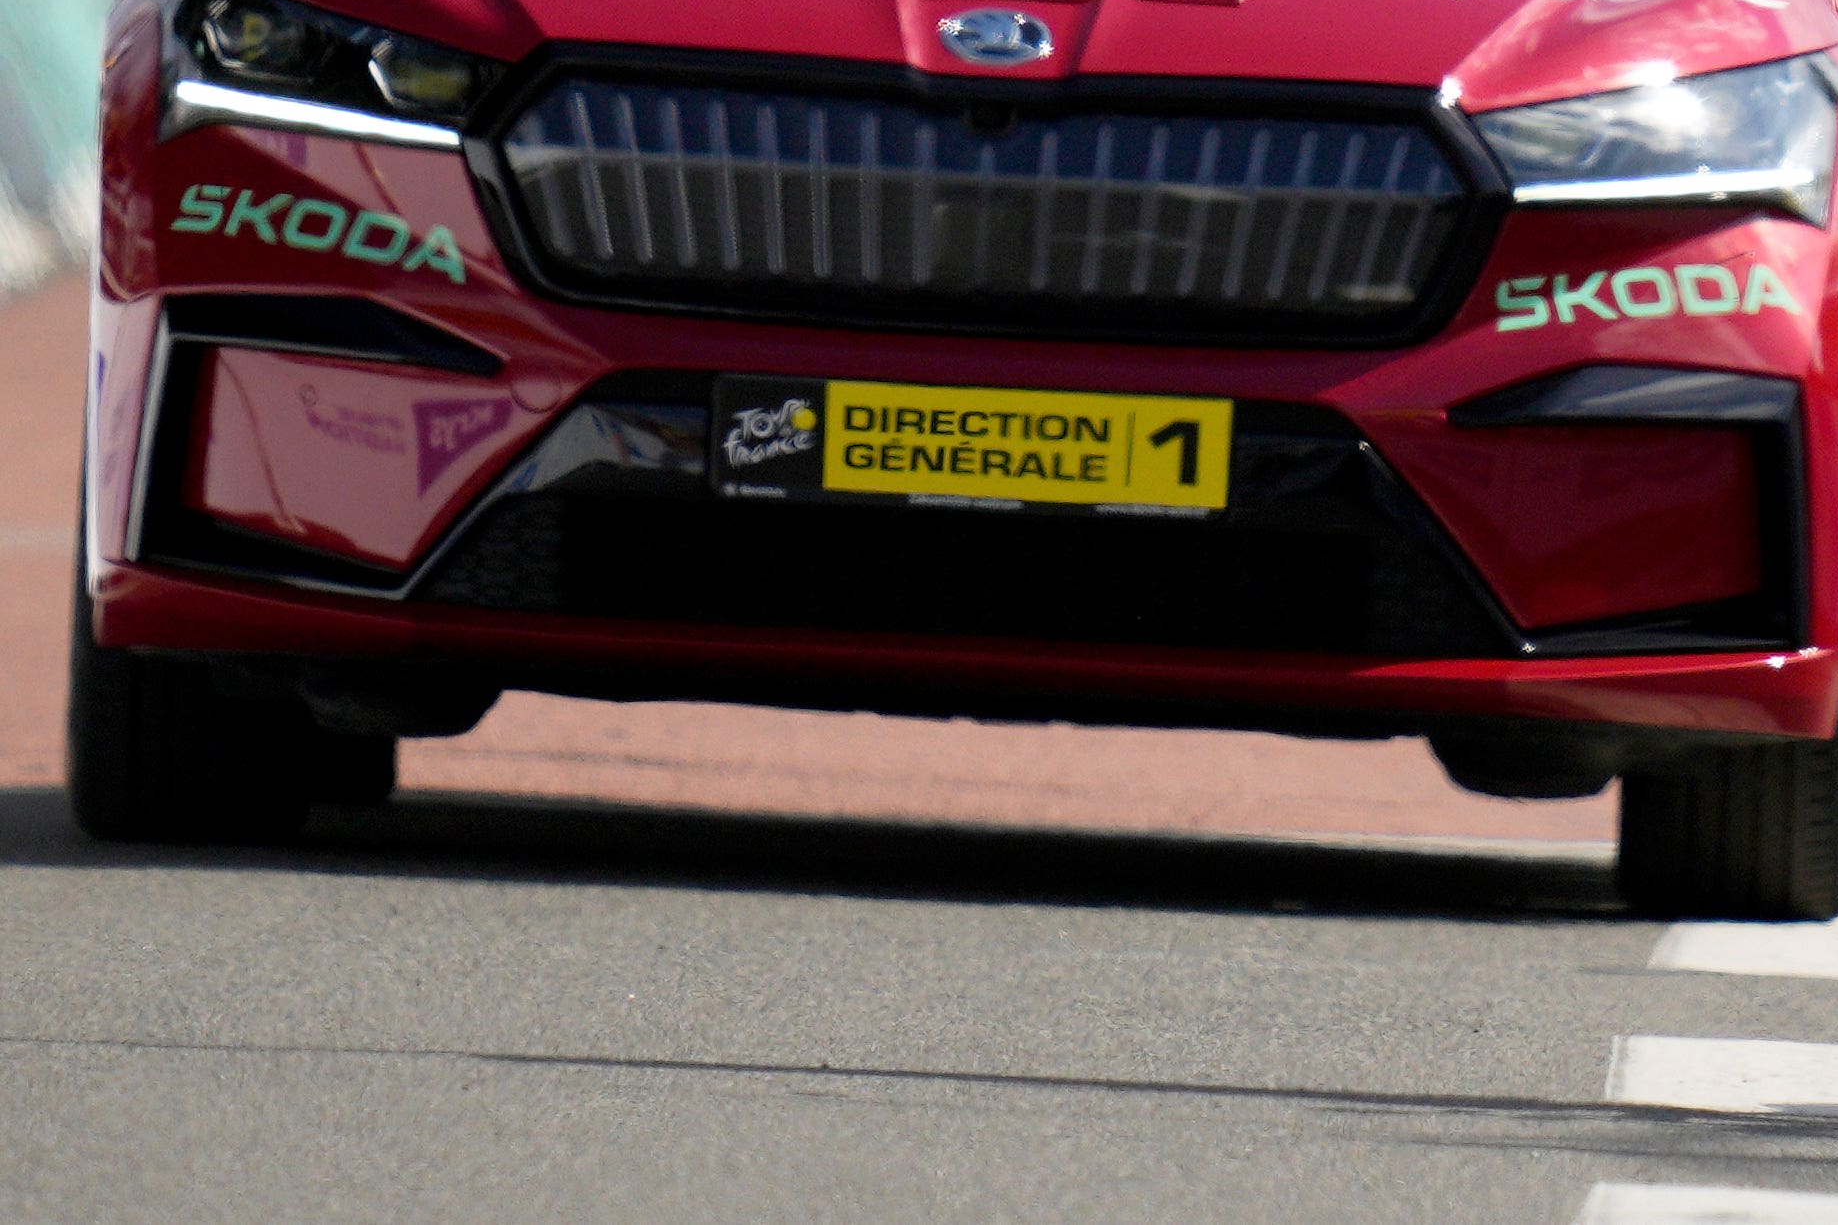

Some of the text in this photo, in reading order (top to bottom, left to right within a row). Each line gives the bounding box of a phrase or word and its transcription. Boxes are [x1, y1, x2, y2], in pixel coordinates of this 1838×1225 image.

[844, 405, 1111, 444] DIRECTION
[843, 439, 1110, 483] GÉNÉRALE
[1149, 418, 1201, 488] 1
